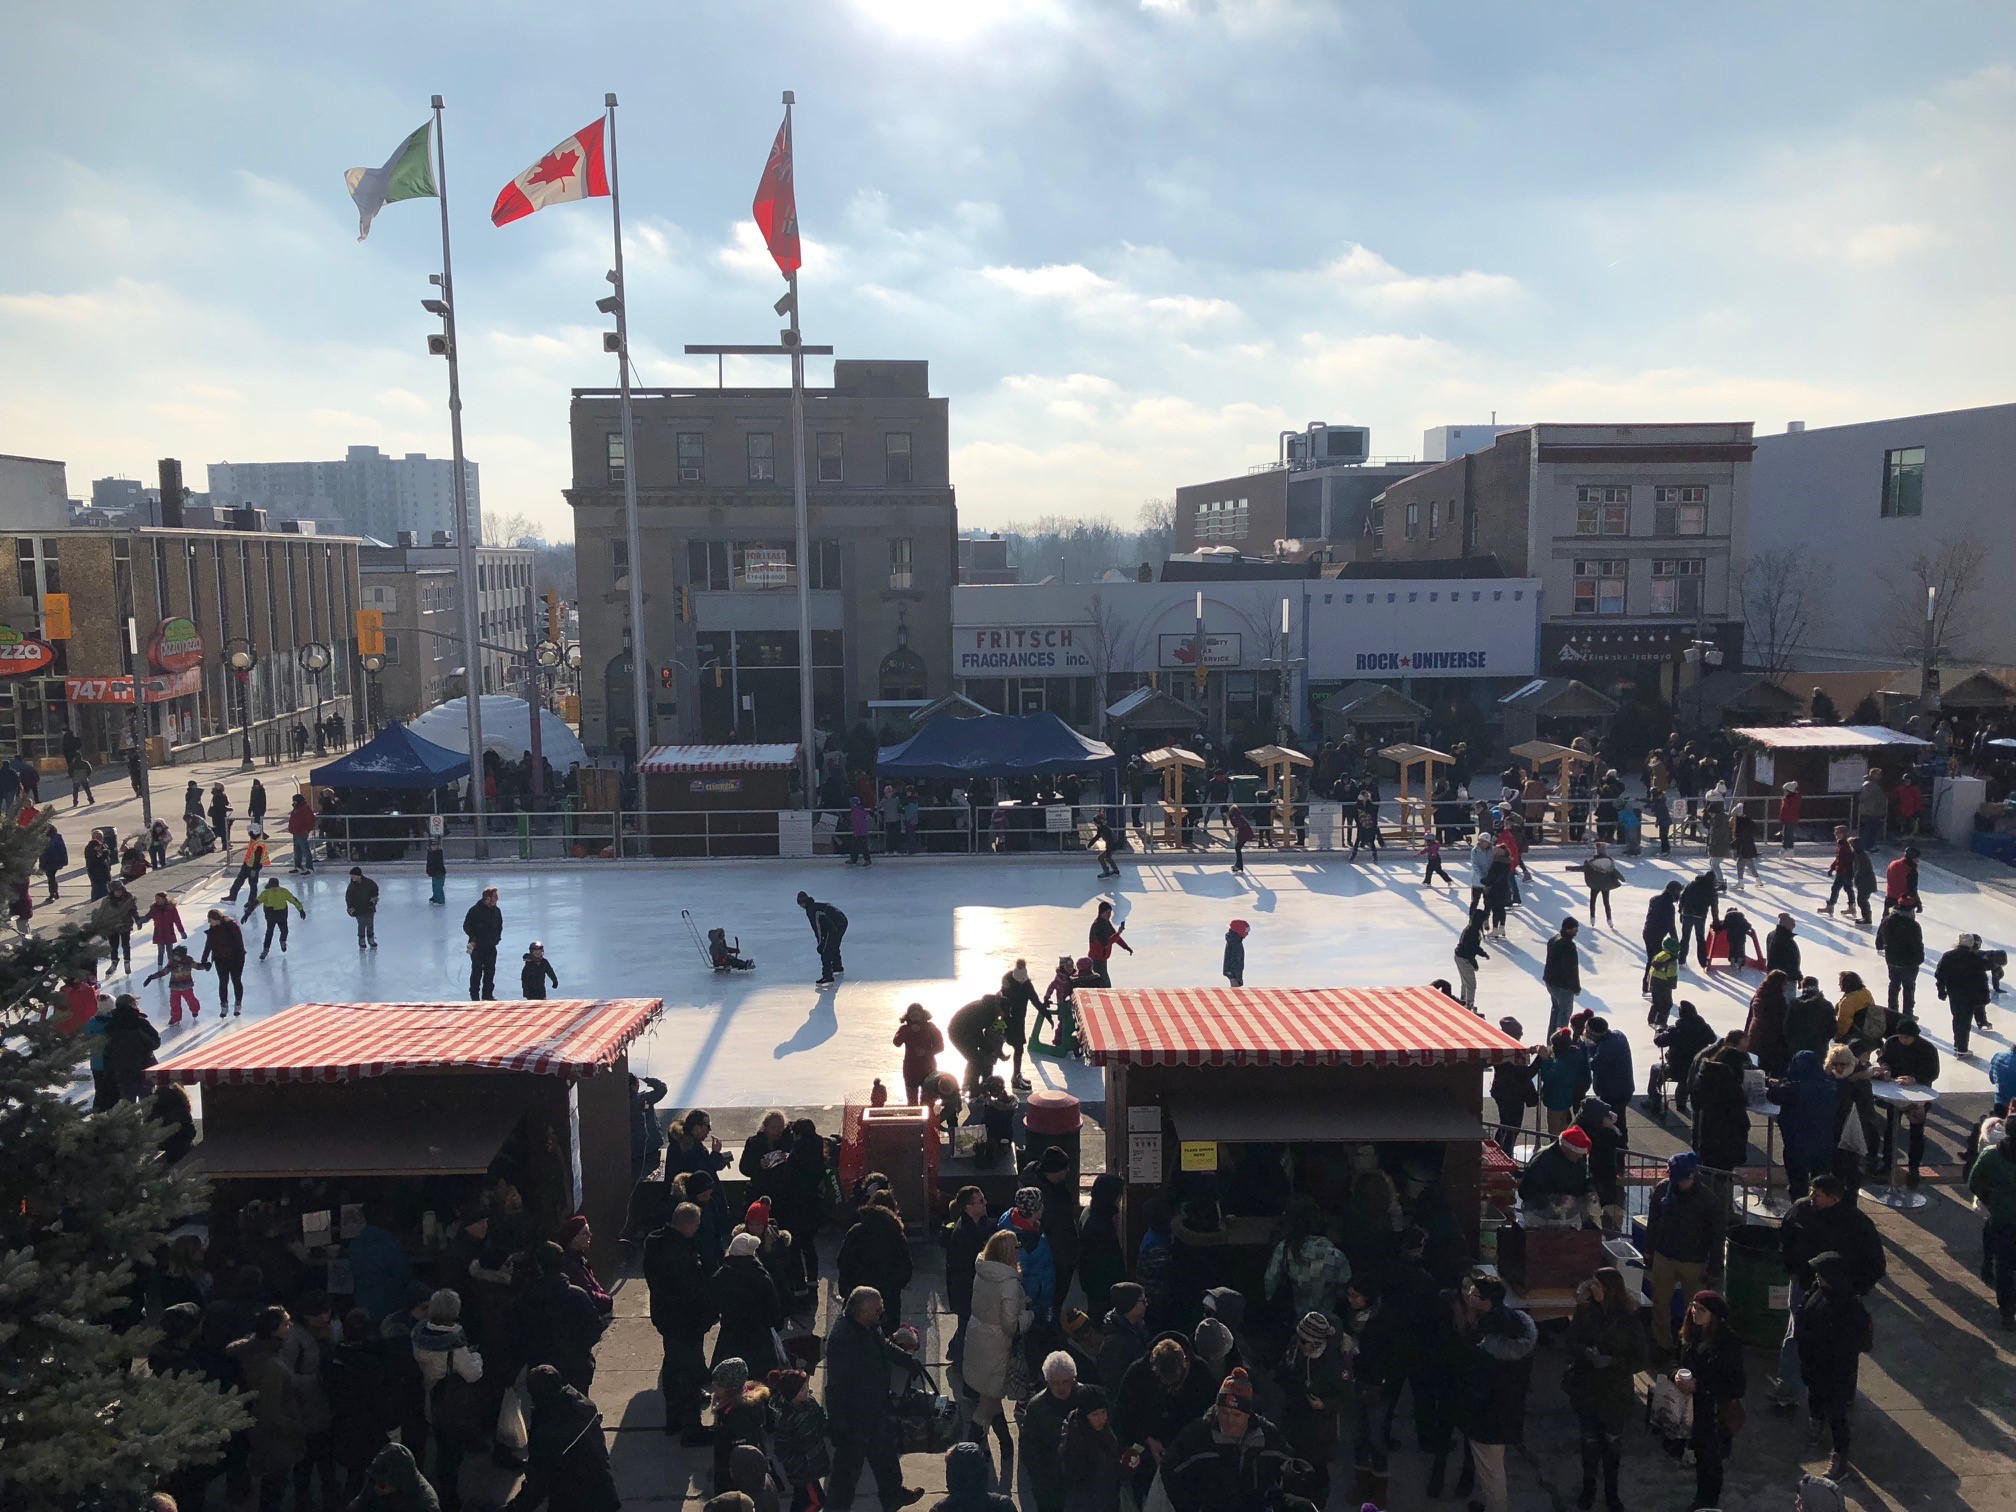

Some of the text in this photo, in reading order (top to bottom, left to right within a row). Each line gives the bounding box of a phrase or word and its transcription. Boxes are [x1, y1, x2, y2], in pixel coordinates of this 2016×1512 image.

[976, 629, 1073, 648] FRITSCH
[962, 652, 1090, 668] FRAGRANCES inc.
[1356, 651, 1487, 670] ROCK UNIVERSE
